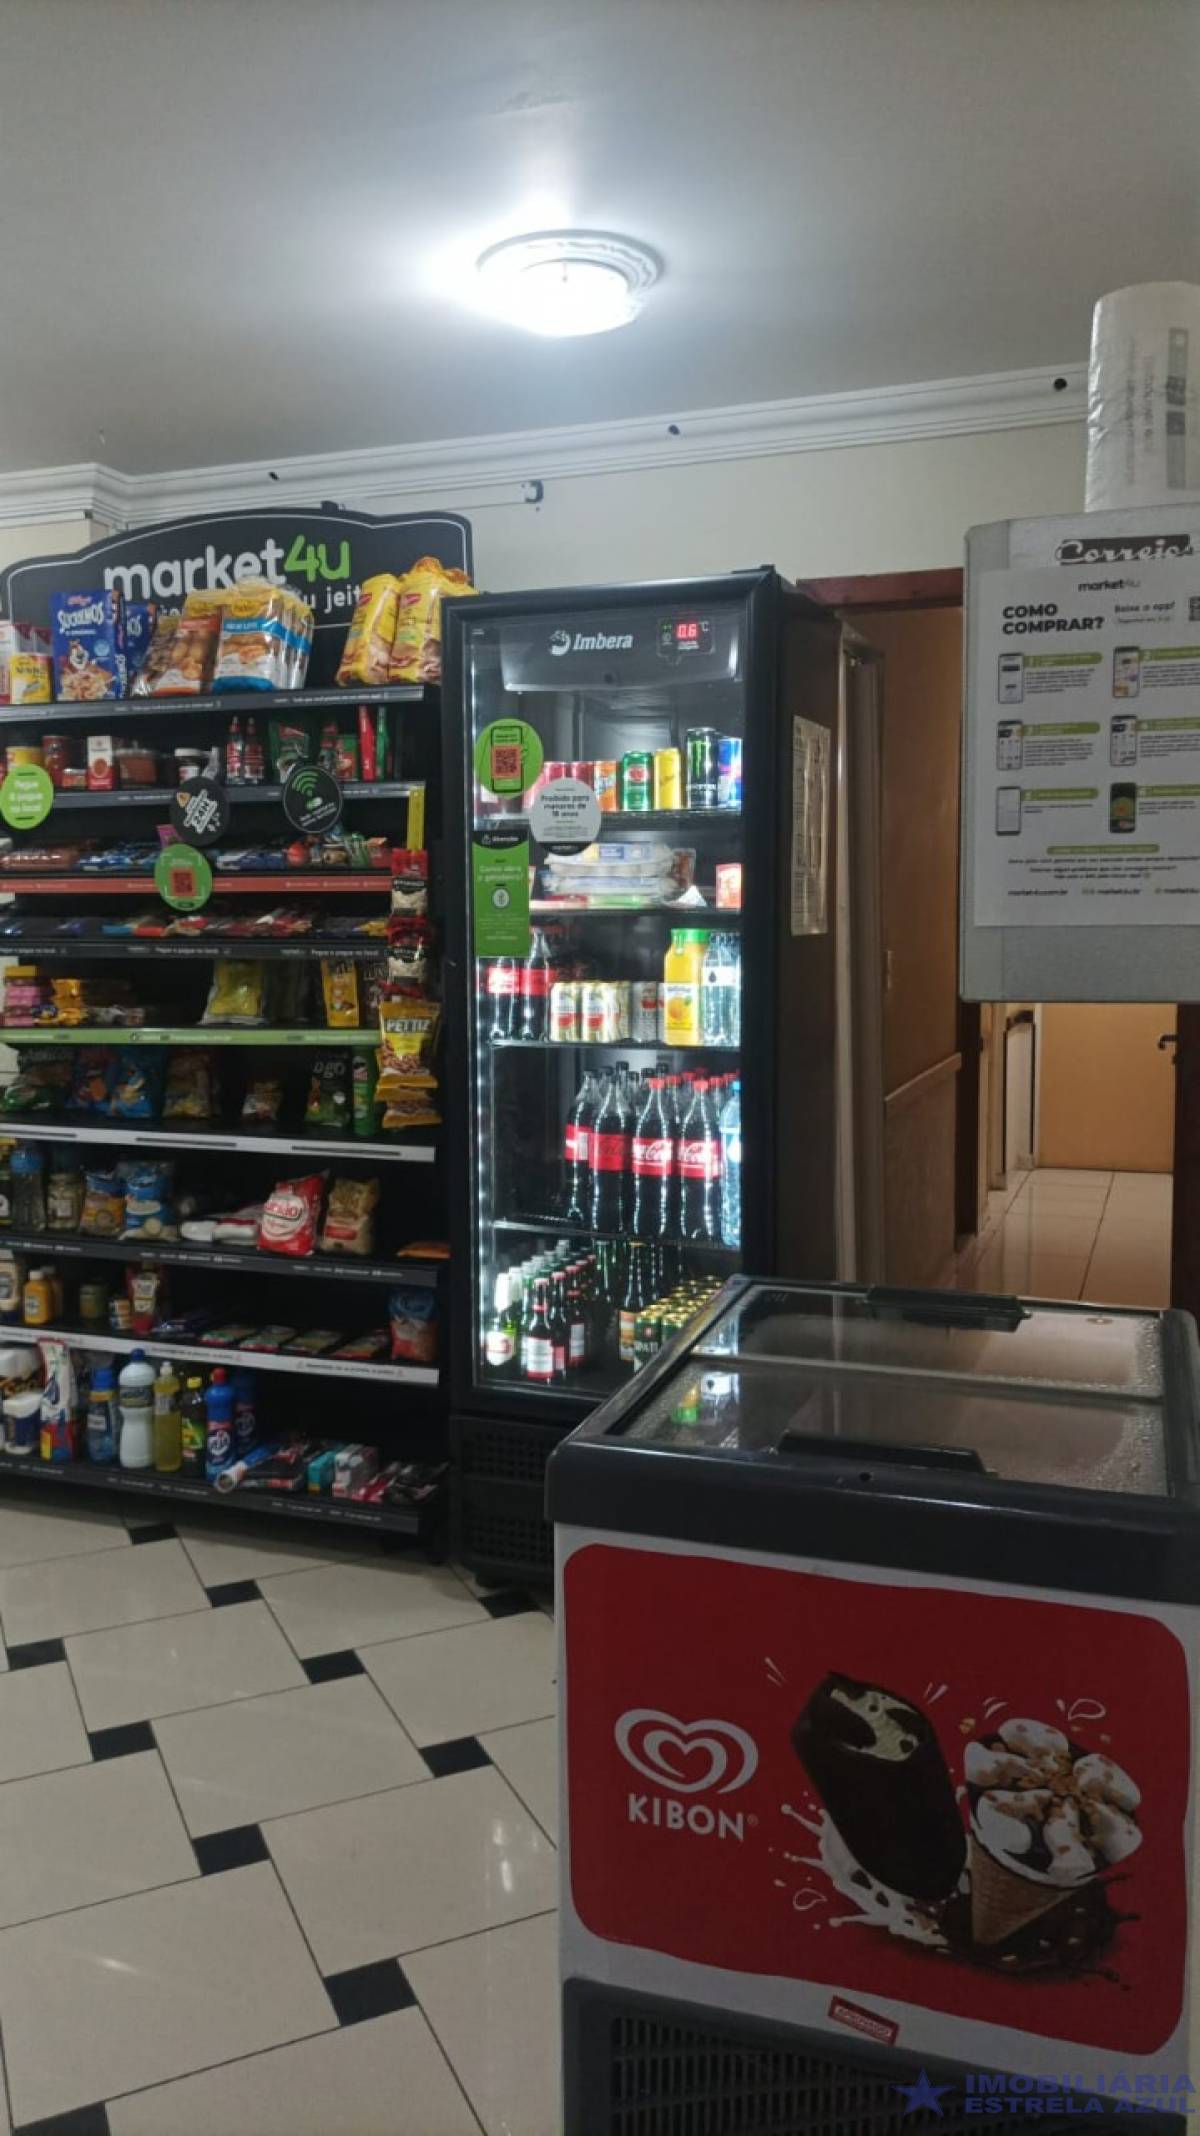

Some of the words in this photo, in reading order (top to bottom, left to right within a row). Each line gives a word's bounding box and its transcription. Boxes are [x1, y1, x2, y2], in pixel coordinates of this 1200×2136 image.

[103, 535, 350, 601] market4u
[1003, 603, 1058, 619] COMO
[1003, 617, 1105, 635] COMPRAR?
[573, 632, 634, 651] Imbera
[627, 1792, 744, 1842] KIBON
